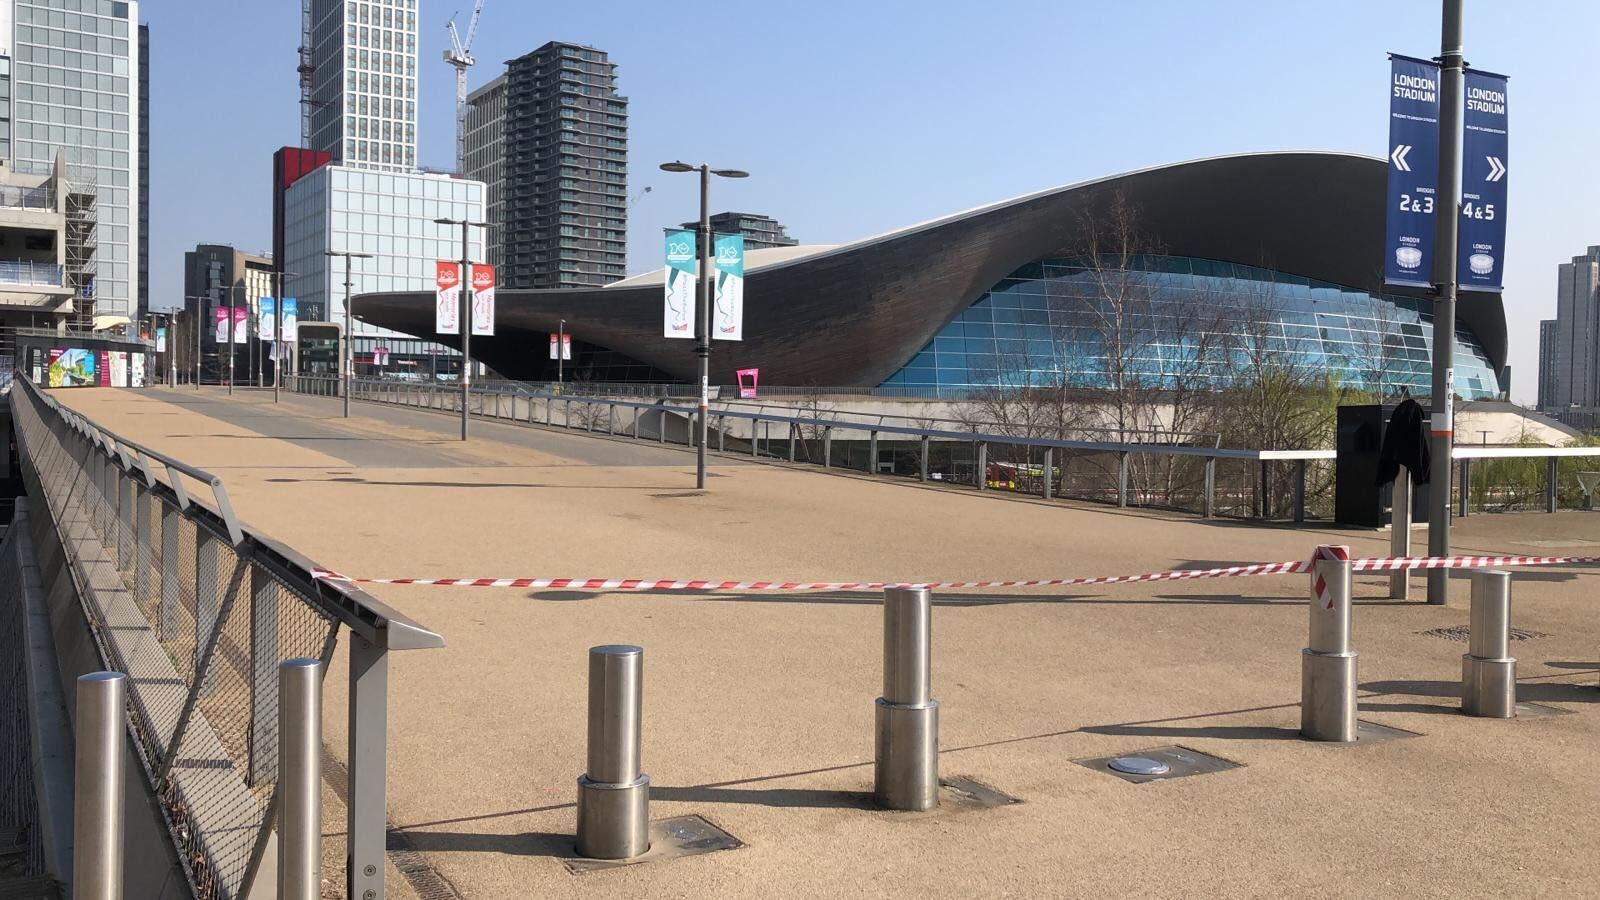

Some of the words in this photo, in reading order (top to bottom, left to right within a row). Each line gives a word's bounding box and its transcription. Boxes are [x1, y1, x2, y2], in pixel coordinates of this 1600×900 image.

[1394, 73, 1435, 91] LONDON
[1394, 87, 1435, 103] STADIUM
[1467, 87, 1504, 103] LONDON
[1467, 100, 1504, 114] STADIUM
[1400, 194, 1410, 211] 2
[1411, 199, 1421, 212] &
[1423, 197, 1433, 214] 3
[1463, 202, 1473, 218] 4
[1474, 207, 1483, 219] &
[1485, 204, 1494, 220] 5
